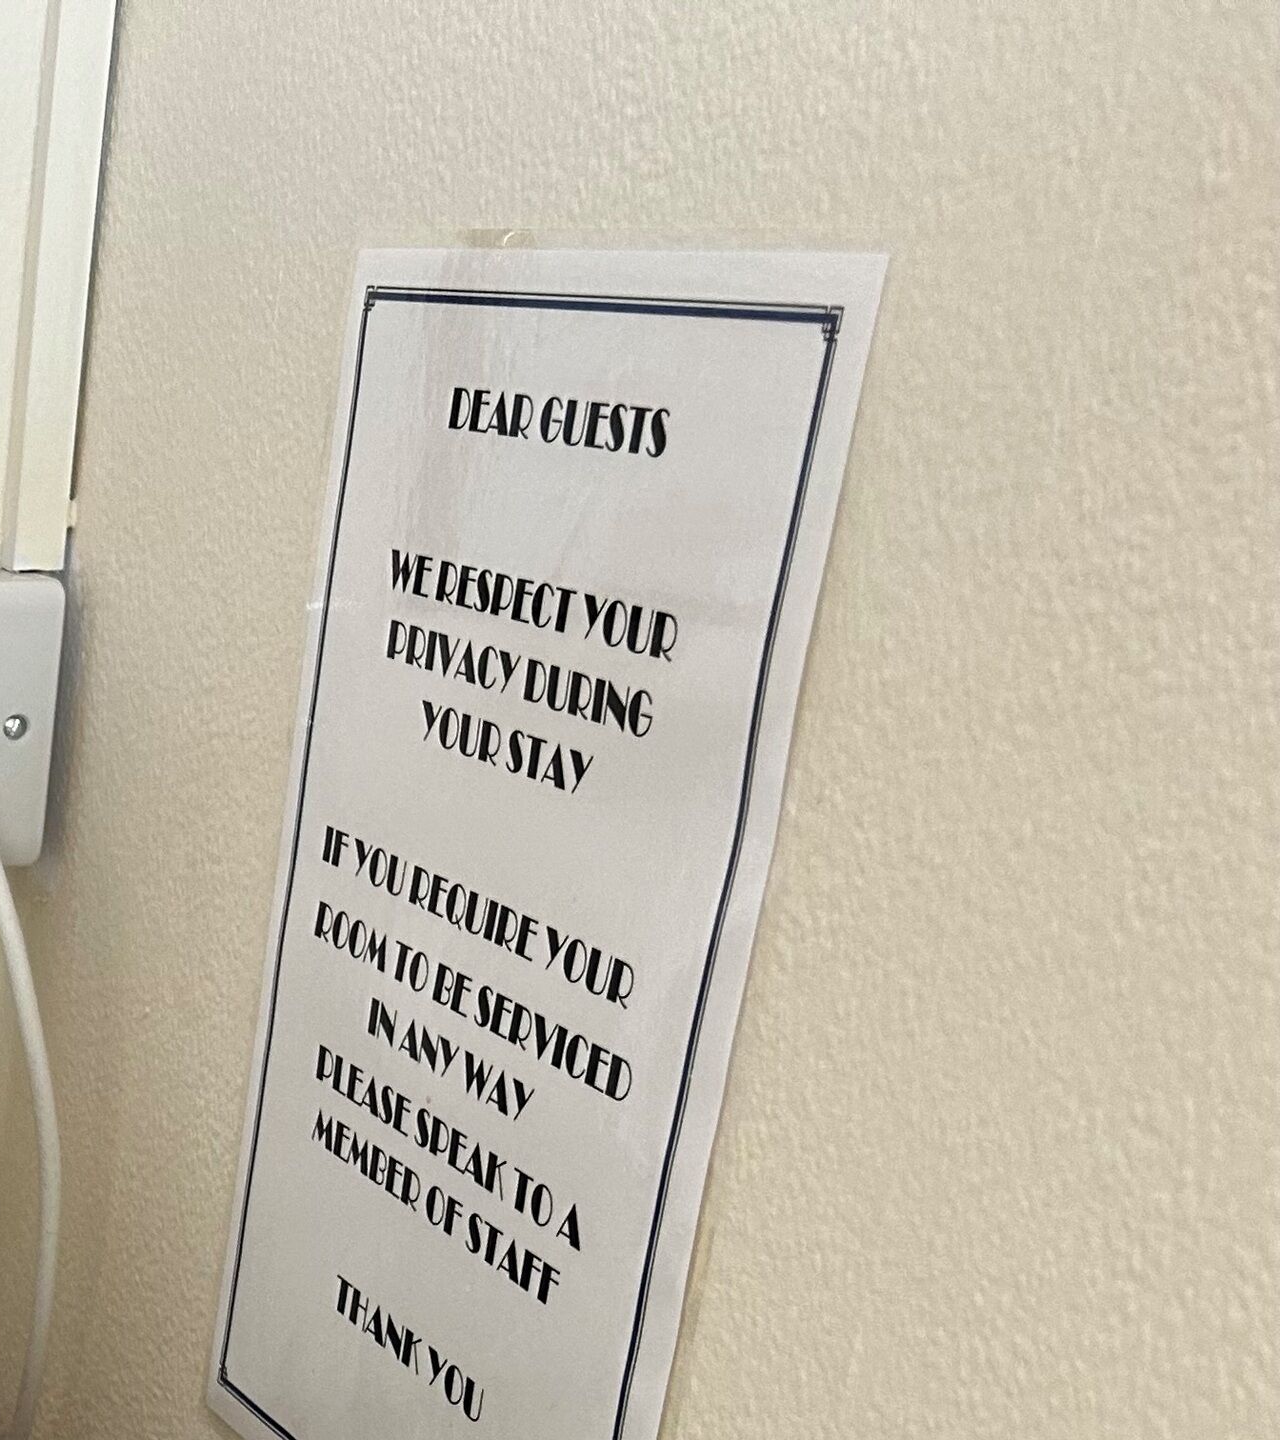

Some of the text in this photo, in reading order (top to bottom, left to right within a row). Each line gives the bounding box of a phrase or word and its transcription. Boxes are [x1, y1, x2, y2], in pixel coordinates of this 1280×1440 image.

[447, 386, 671, 458] DEAR GUESTS
[391, 548, 678, 663] WE RESPECT YOUR
[385, 620, 654, 738] PRIVACY DURING
[421, 699, 594, 795] YOUR STAY
[321, 825, 636, 1009] IF YOU REQUIRE YOUR
[313, 900, 633, 1103] ROOM TO BE SERVICED
[366, 997, 536, 1121] IN ANY WAY
[311, 1109, 561, 1305] MEMBER OF STAFF
[315, 1044, 582, 1252] PLEASE SPEAK TO A
[336, 1274, 485, 1422] THANK YOU
